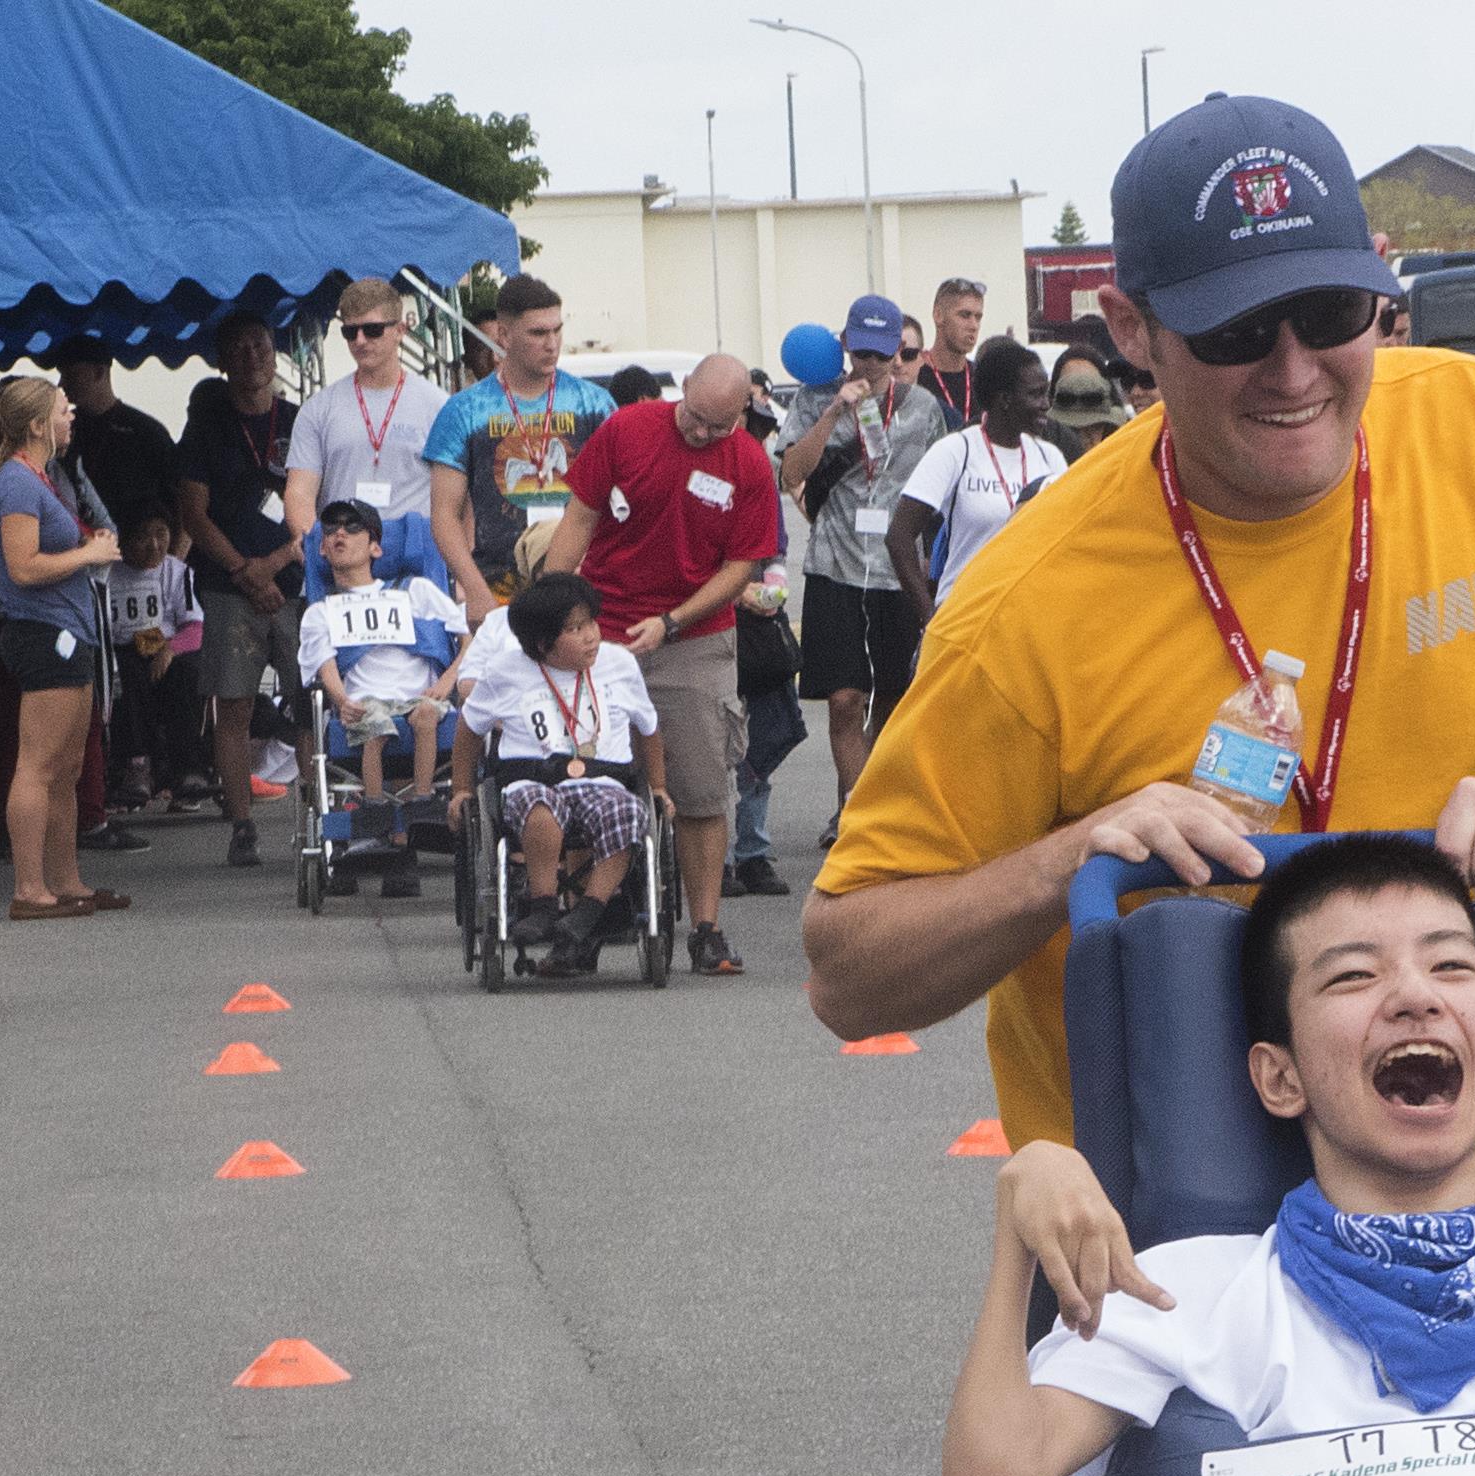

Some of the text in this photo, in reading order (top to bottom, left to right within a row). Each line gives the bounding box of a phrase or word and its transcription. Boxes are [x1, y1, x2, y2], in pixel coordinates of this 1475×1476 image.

[1195, 157, 1237, 221] COMMANDER
[1237, 147, 1268, 163] FLEET
[1287, 154, 1329, 196] FORWARD
[1257, 215, 1314, 234] OKINAWA
[967, 477, 1002, 494] LIVE
[342, 607, 402, 634] 104
[1328, 1429, 1385, 1463] T7
[1401, 1453, 1468, 1472] Special
